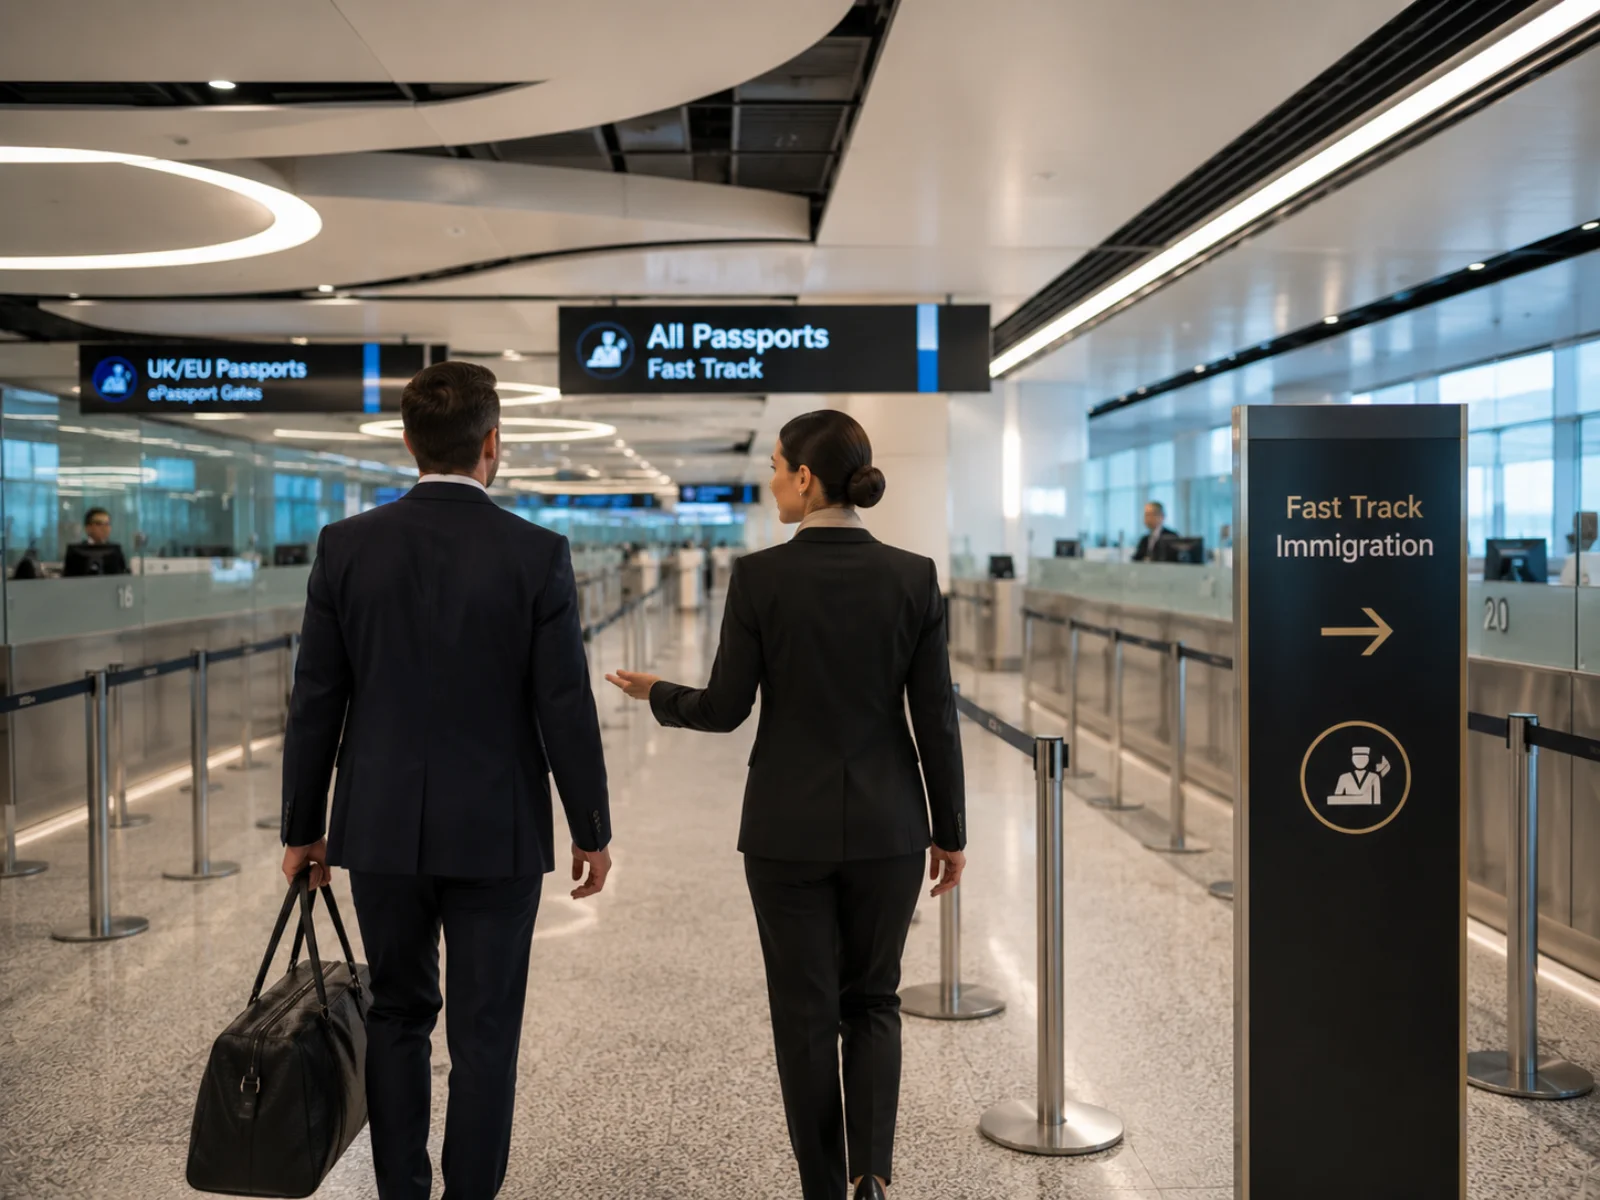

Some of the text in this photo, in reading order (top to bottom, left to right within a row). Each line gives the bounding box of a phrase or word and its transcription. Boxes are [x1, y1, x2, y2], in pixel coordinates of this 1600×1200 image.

[646, 323, 830, 355] All Passports
[147, 358, 308, 382] UK/EU Passports
[647, 356, 764, 379] Fast Track
[147, 384, 263, 404] ePassport Gates
[1287, 494, 1424, 519] Fast Track
[1276, 532, 1434, 563] Immigration
[1484, 596, 1509, 633] 20
